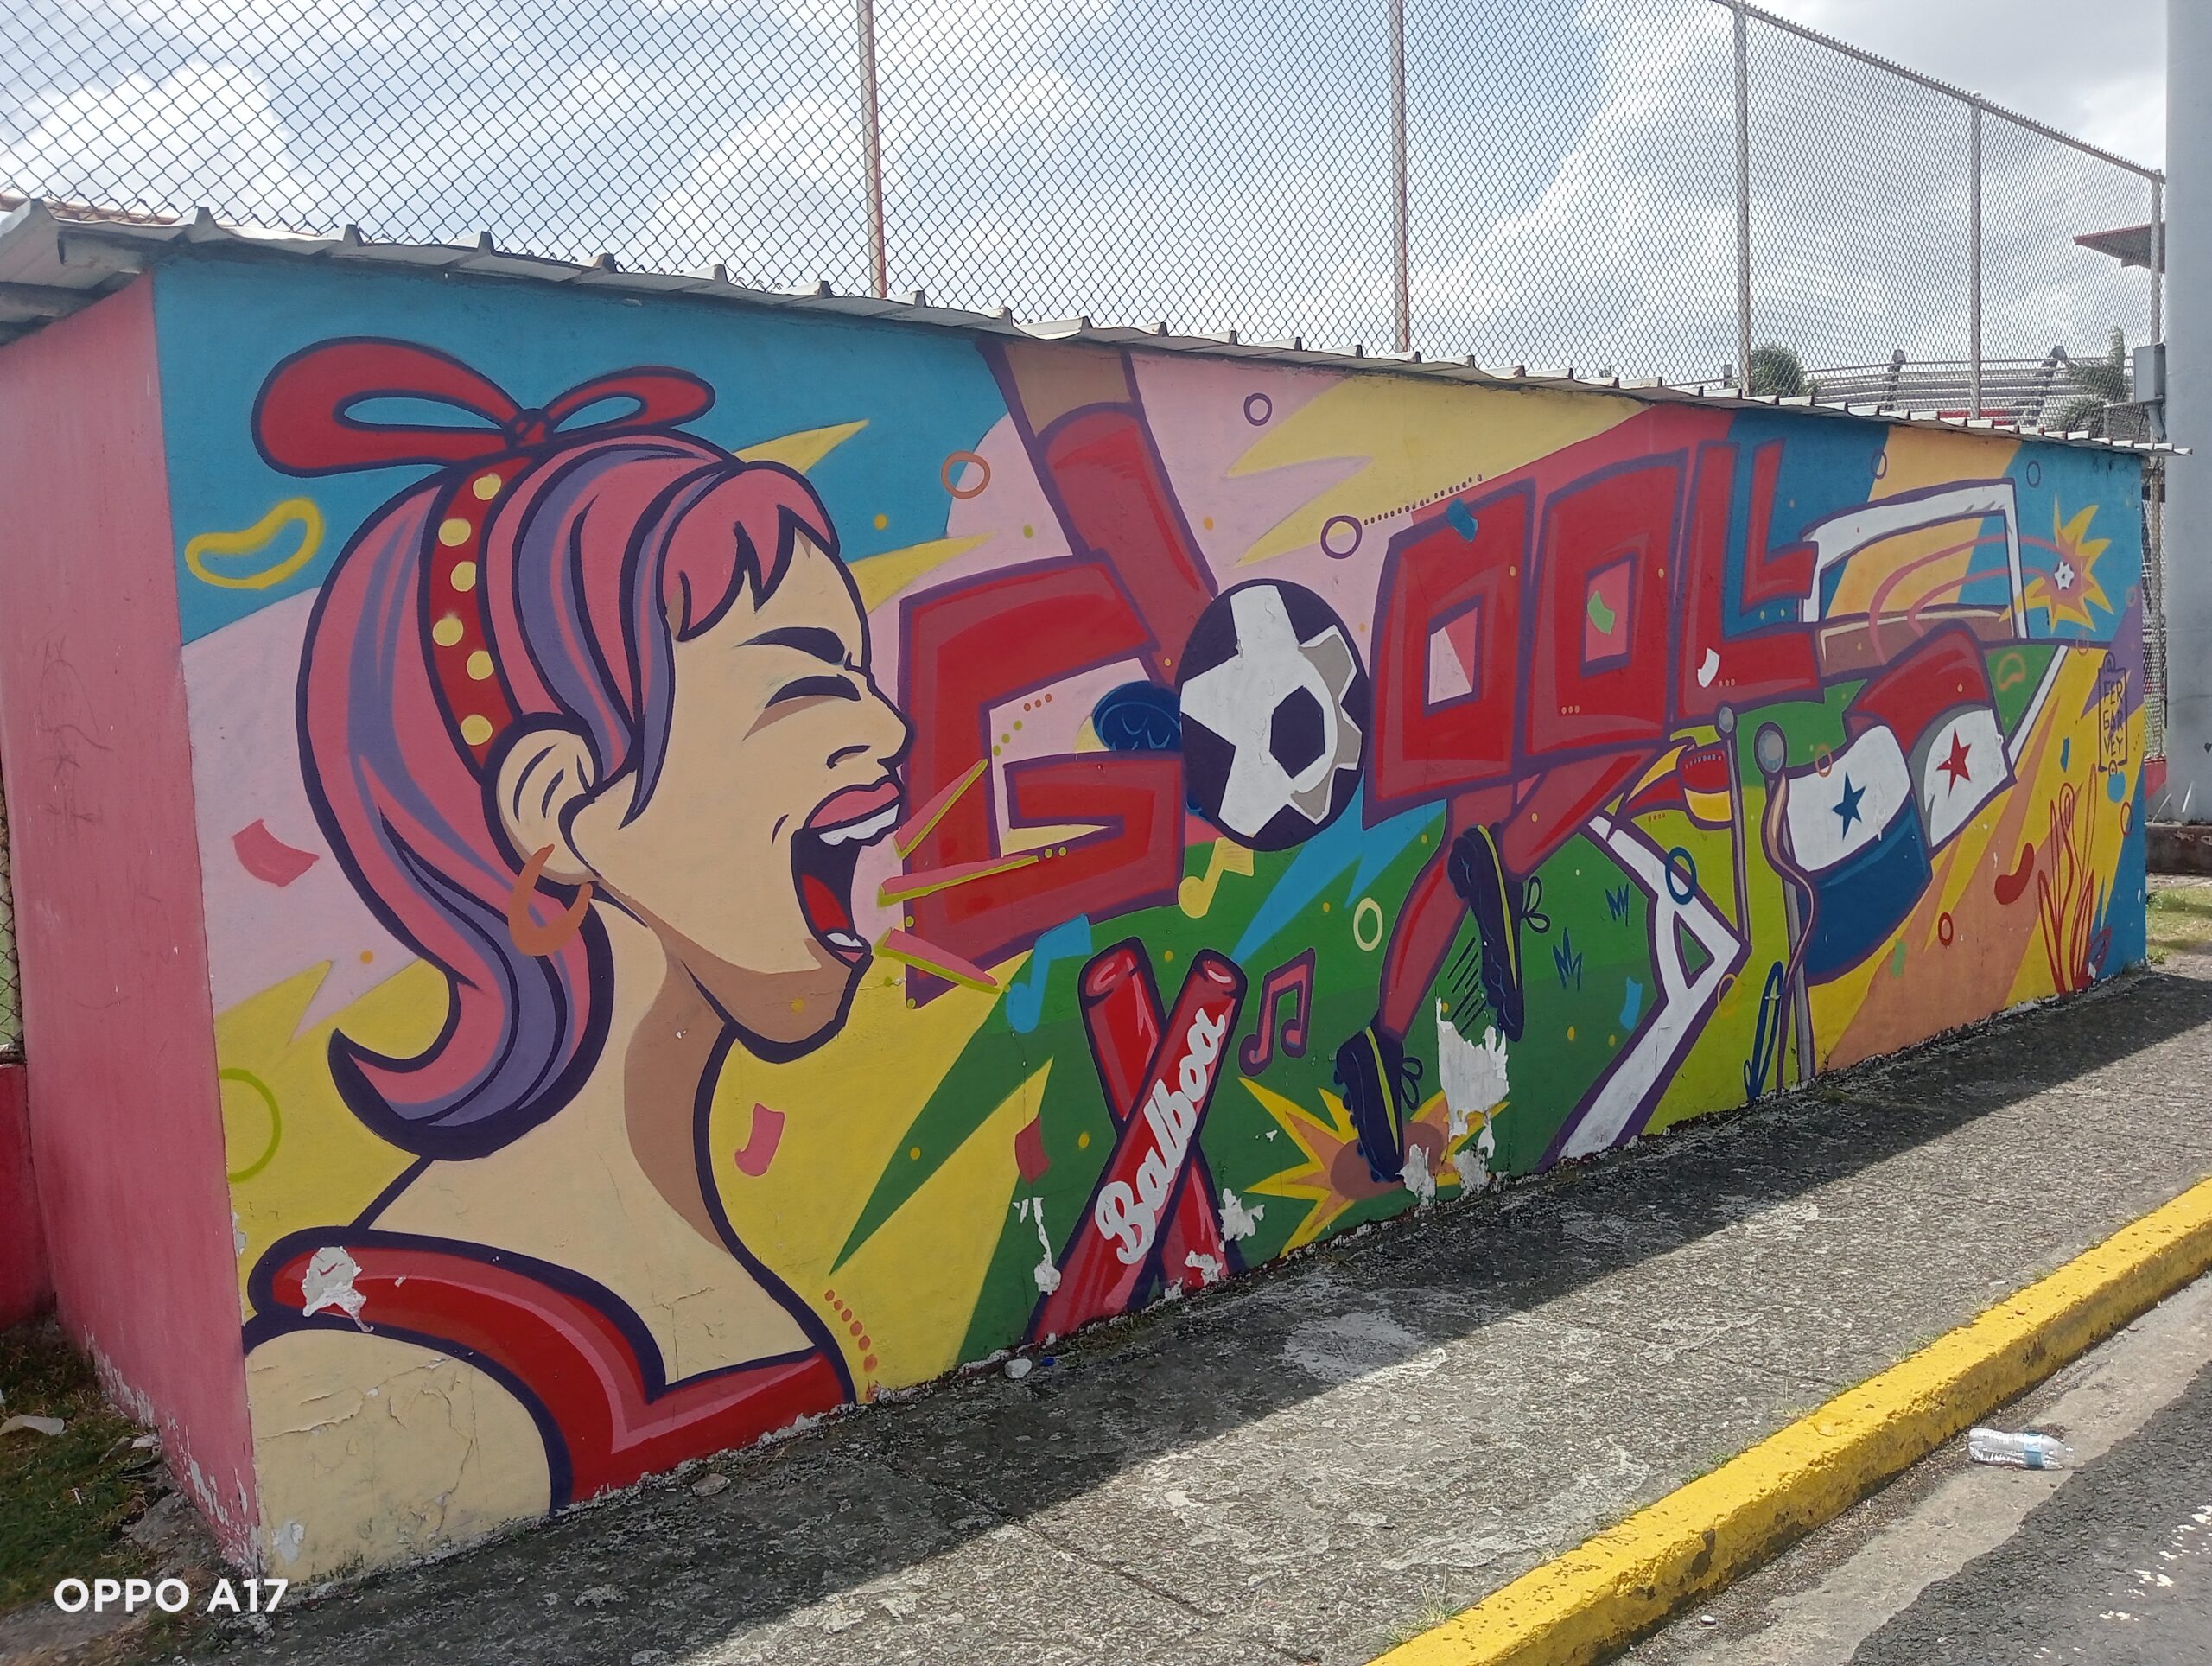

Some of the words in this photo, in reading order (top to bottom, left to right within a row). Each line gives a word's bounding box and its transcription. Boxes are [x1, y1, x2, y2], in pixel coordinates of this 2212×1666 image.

[2102, 679, 2124, 705] FER
[2102, 709, 2124, 732] GAR
[1094, 1008, 1225, 1265] Balboa
